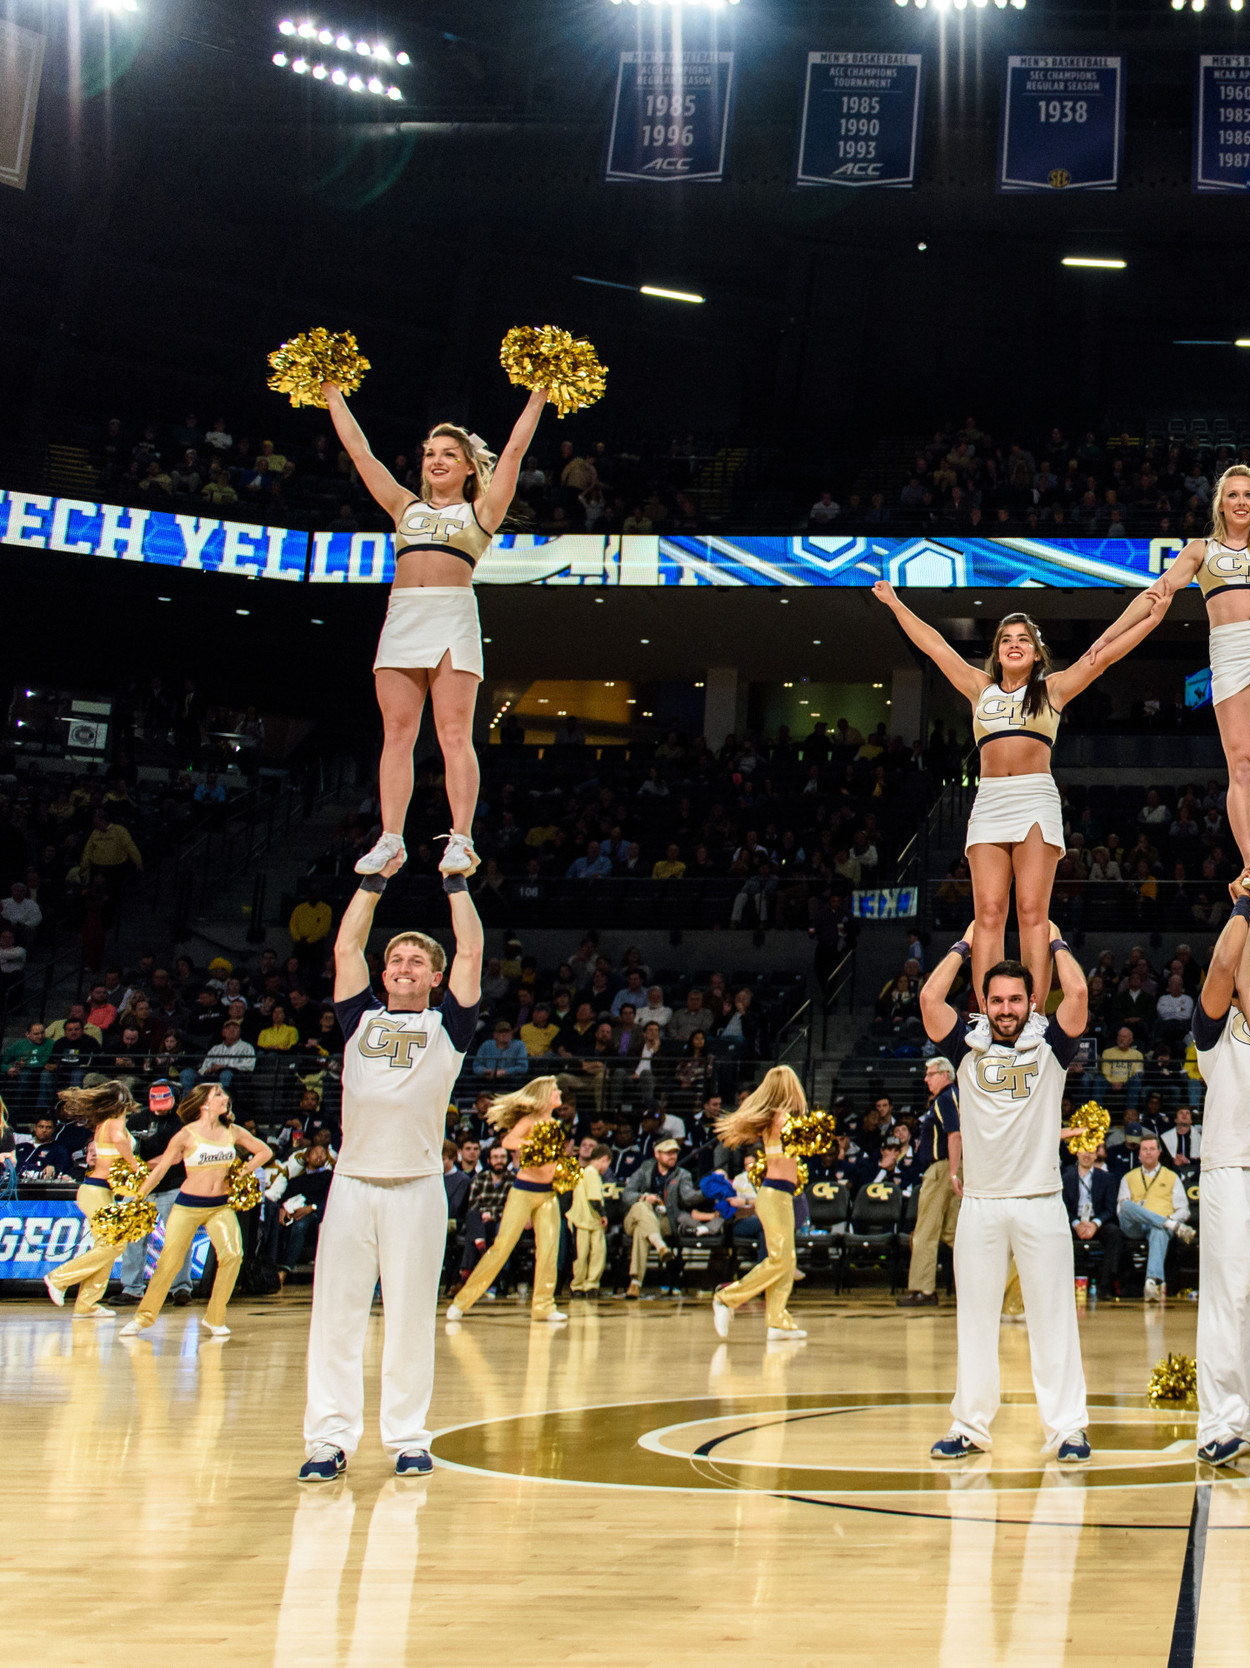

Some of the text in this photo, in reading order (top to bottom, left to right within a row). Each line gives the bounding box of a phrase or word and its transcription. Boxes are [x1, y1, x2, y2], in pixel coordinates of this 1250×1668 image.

[820, 53, 909, 65] MEN'S BASKETBALL
[1020, 58, 1108, 67] MEN'S BASKETBALL
[1212, 56, 1241, 66] MEN'S
[829, 67, 898, 78] ACC CHAMPIONS
[1030, 71, 1097, 81] SEC CHAMPIONS
[1214, 70, 1236, 79] NCAA
[834, 78, 891, 88] TOURNAMENT
[1026, 81, 1100, 91] REGULAR SEASON
[646, 95, 697, 117] 1985
[842, 96, 880, 114] 1985
[1038, 101, 1088, 123] 1938
[1219, 108, 1250, 122] 1985
[840, 118, 880, 136] 1990
[642, 125, 694, 147] 1996
[838, 141, 877, 158] 1993
[642, 158, 693, 170] ACC
[1218, 153, 1250, 167] 1987
[833, 163, 884, 175] ACC
[399, 512, 464, 542] GT
[0, 489, 396, 582] ECH YELLO
[358, 1018, 428, 1069] GT
[976, 1056, 1039, 1099] GT
[812, 1182, 840, 1200] GT
[866, 1183, 894, 1201] GT
